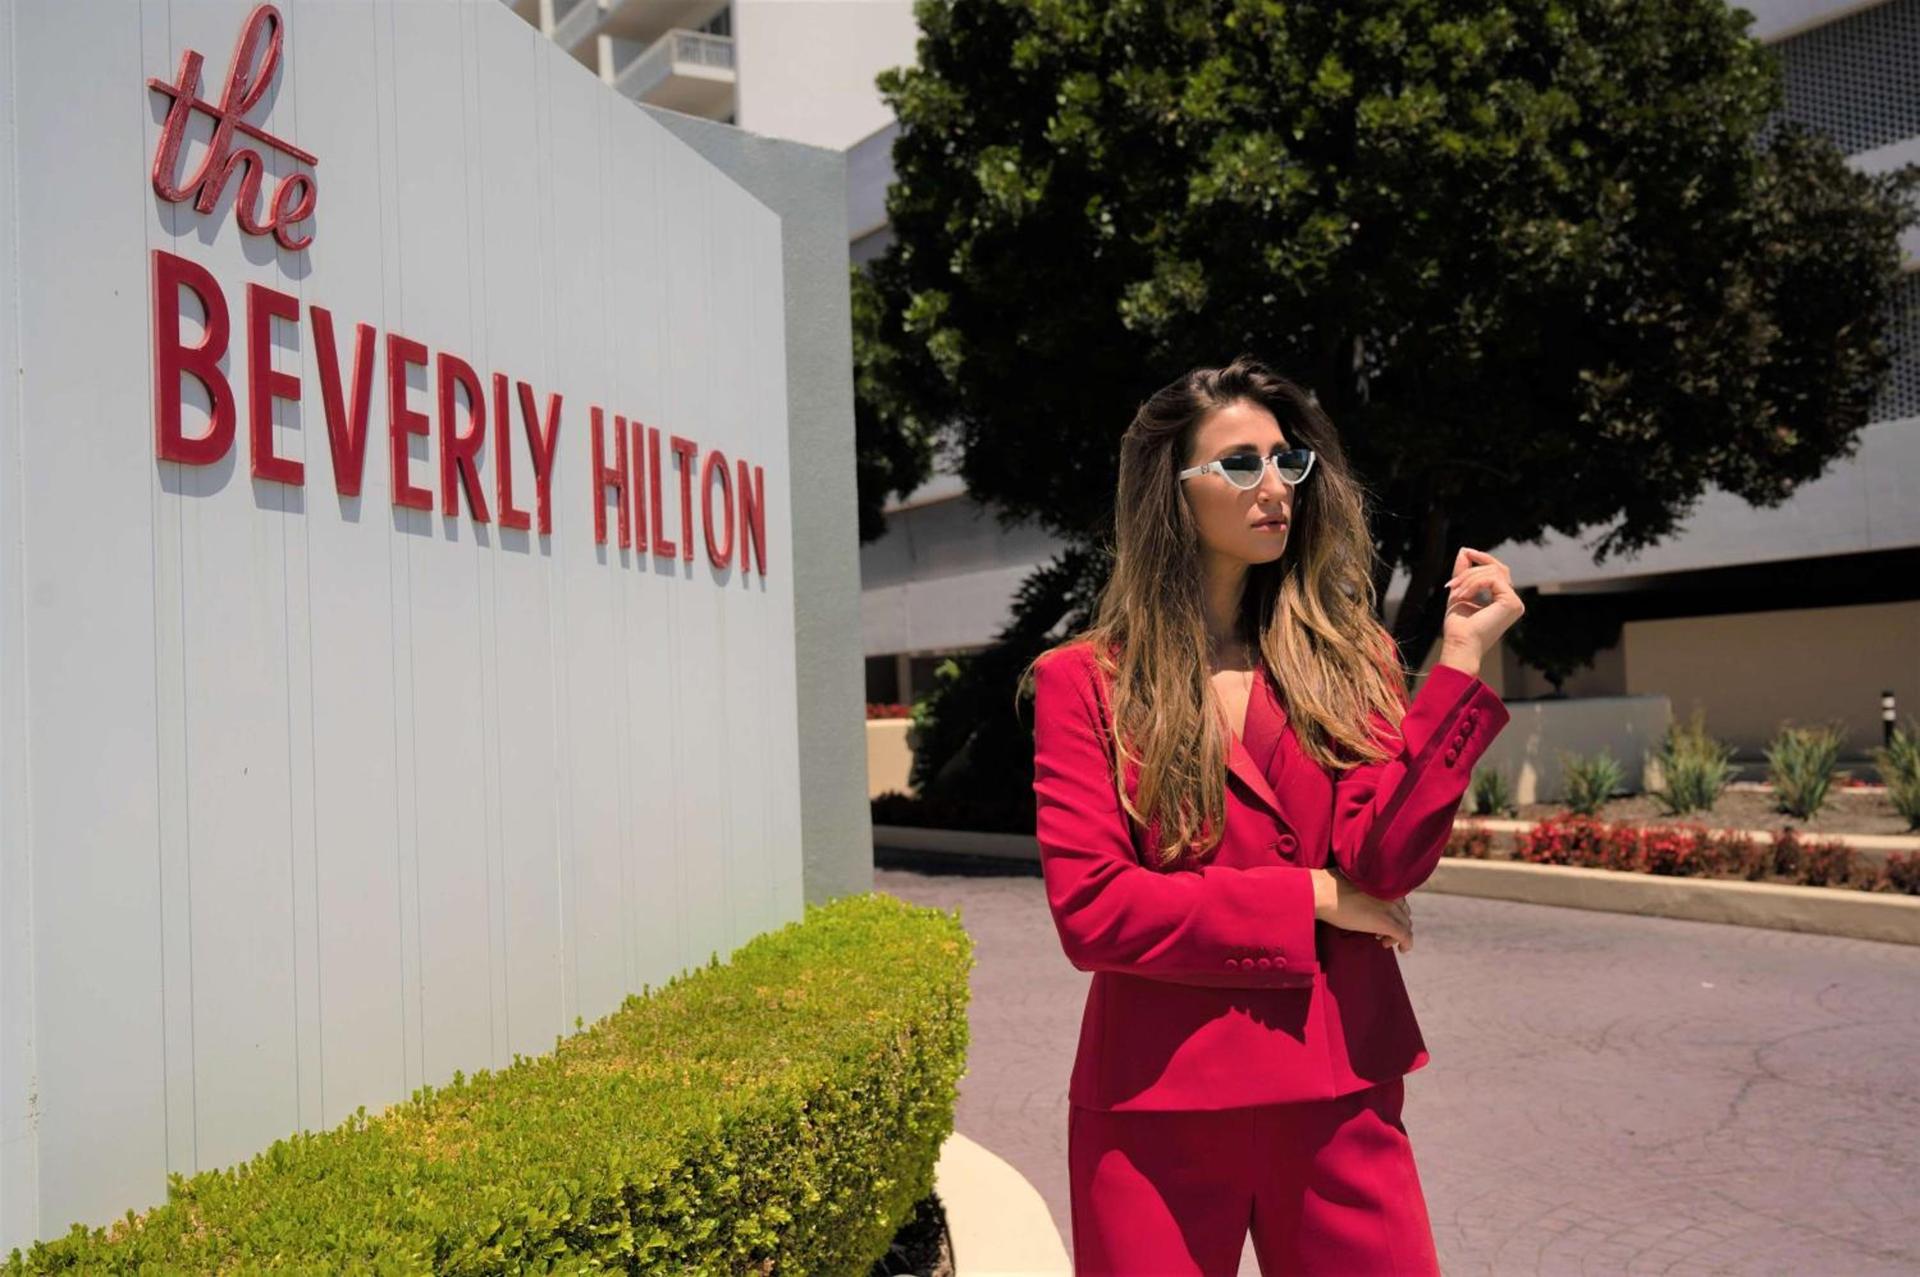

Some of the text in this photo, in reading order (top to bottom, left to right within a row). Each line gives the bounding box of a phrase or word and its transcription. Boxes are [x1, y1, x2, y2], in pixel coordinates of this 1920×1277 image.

[148, 4, 318, 251] the
[152, 249, 767, 576] BEVERLY HILTON
